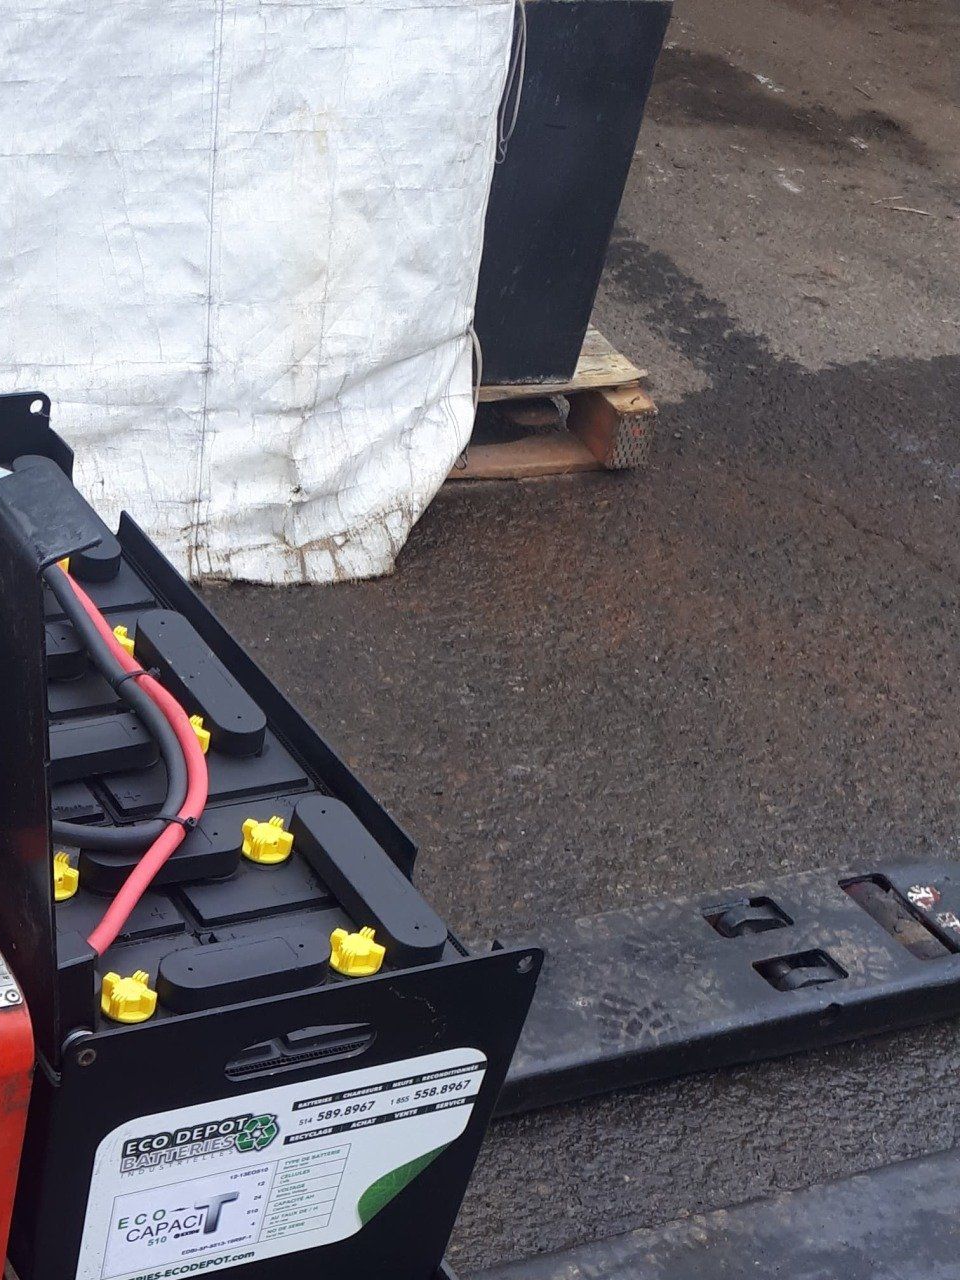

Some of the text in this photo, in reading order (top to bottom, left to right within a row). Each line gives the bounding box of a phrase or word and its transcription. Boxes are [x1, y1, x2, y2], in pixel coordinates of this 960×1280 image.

[290, 1099, 466, 1141] RECYCLAGE ACHAT VENTE SERVICE
[299, 1117, 312, 1126] 514
[317, 1101, 375, 1121] 589.8967
[396, 1096, 409, 1105] 855
[414, 1079, 471, 1100] 558.8967
[121, 1134, 235, 1172] BATTERIES
[125, 1117, 248, 1155] ECO DEPOT
[121, 1150, 234, 1178] INDUSTRIELLES
[118, 1209, 166, 1230] ECO
[147, 1236, 167, 1246] 510
